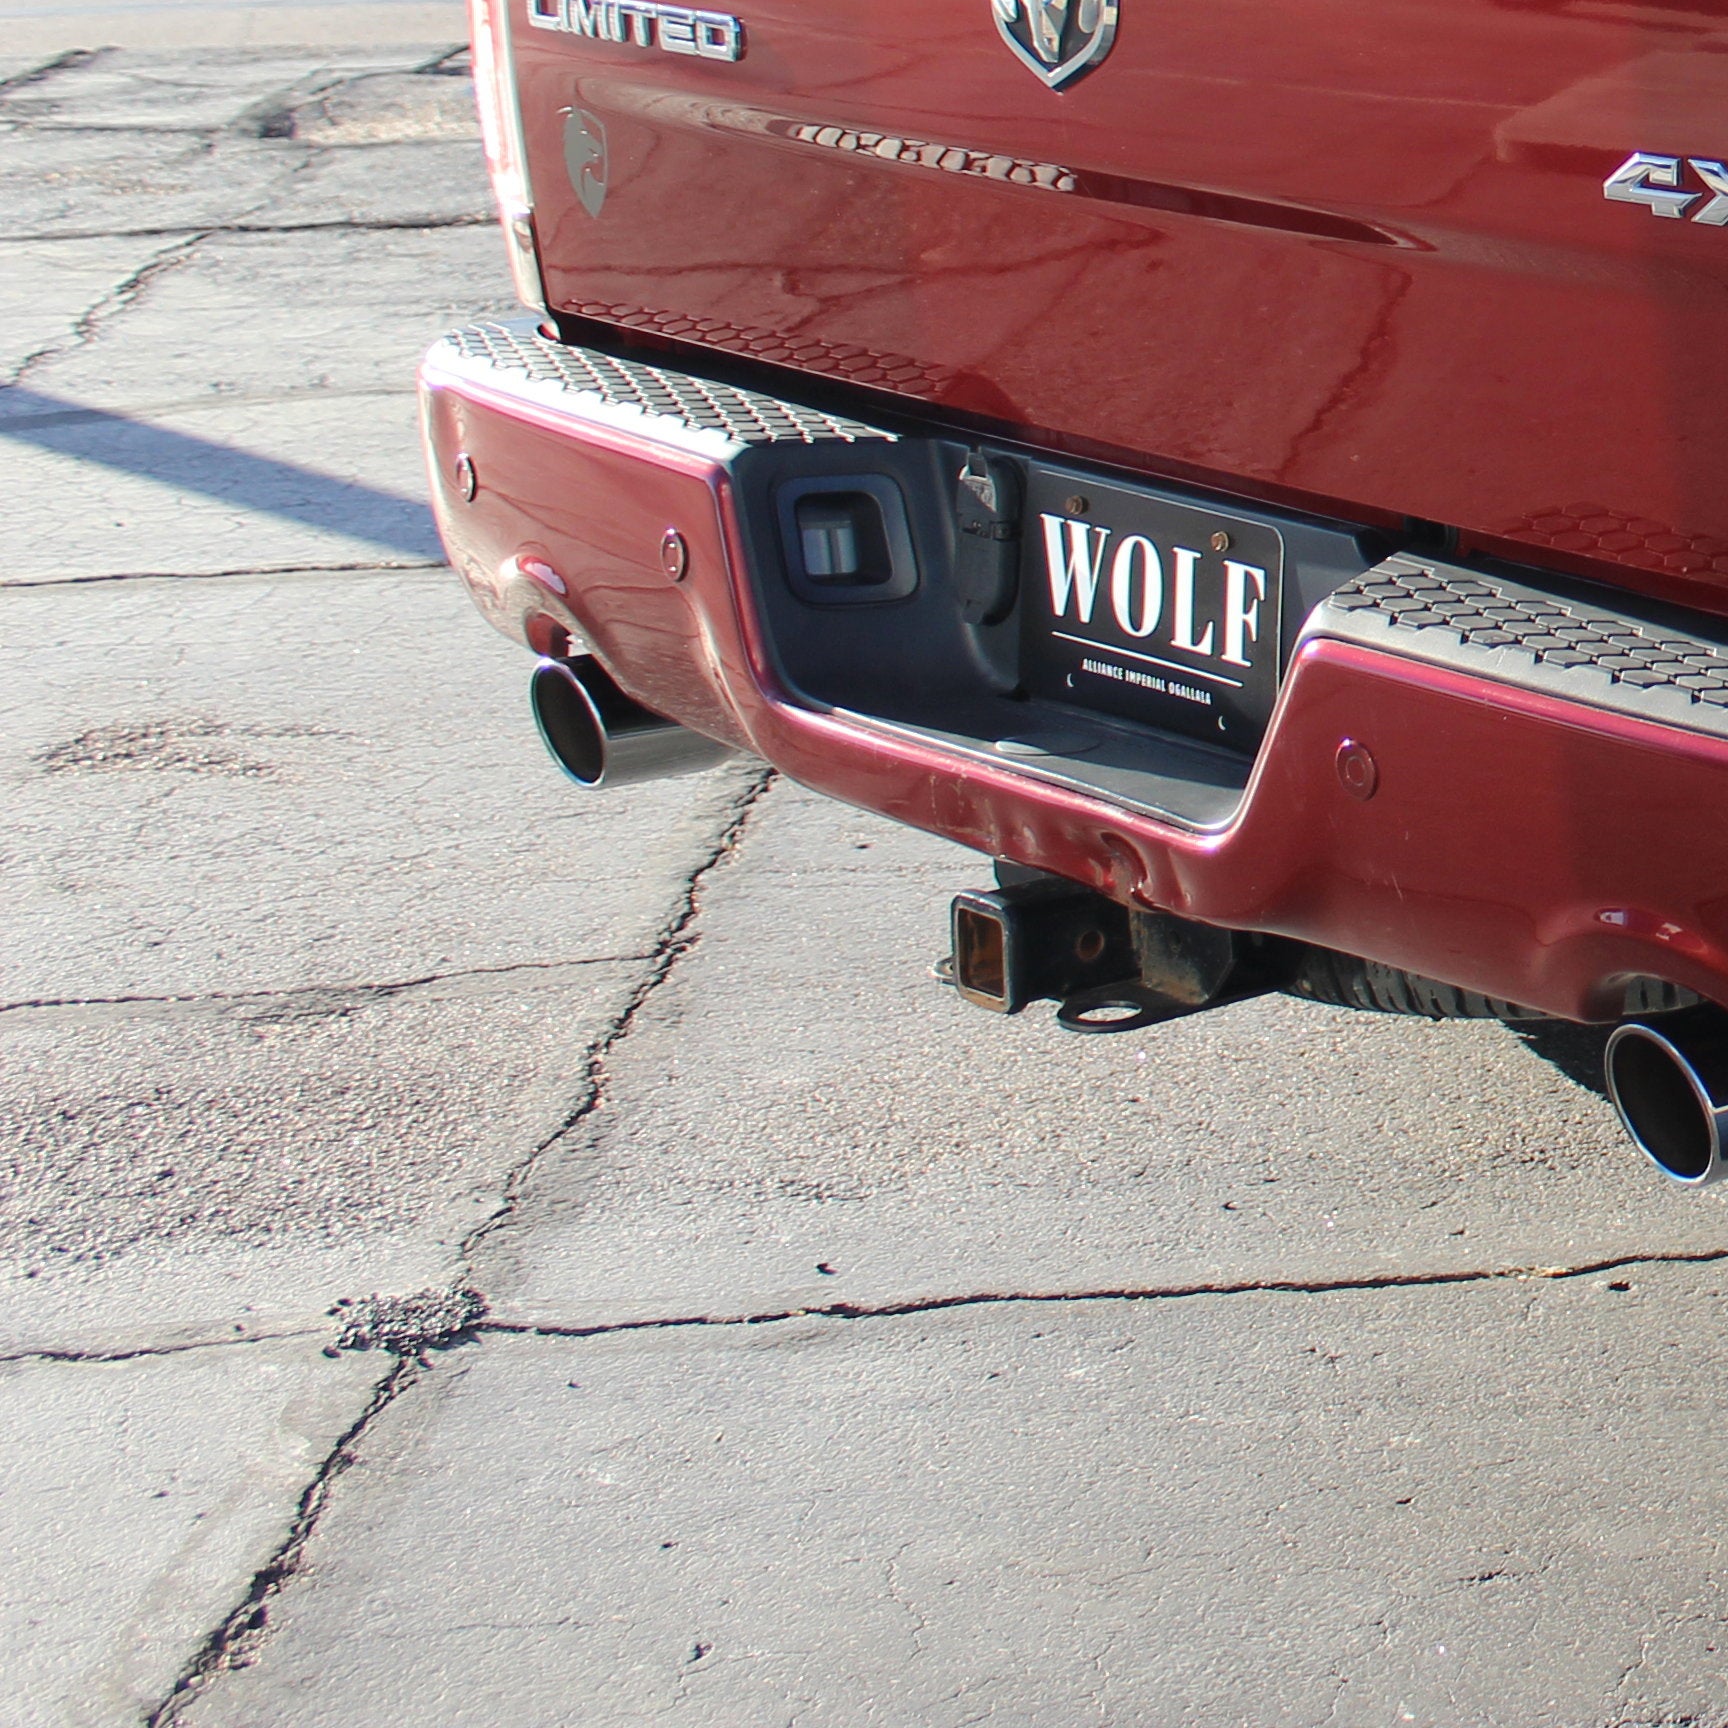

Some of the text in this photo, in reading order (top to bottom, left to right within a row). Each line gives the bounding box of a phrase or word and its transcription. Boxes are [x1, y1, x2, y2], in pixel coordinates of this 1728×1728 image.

[1039, 513, 1267, 667] WOLF
[1082, 658, 1211, 705] ALLIANCE IMPERIAL OGALLALA
